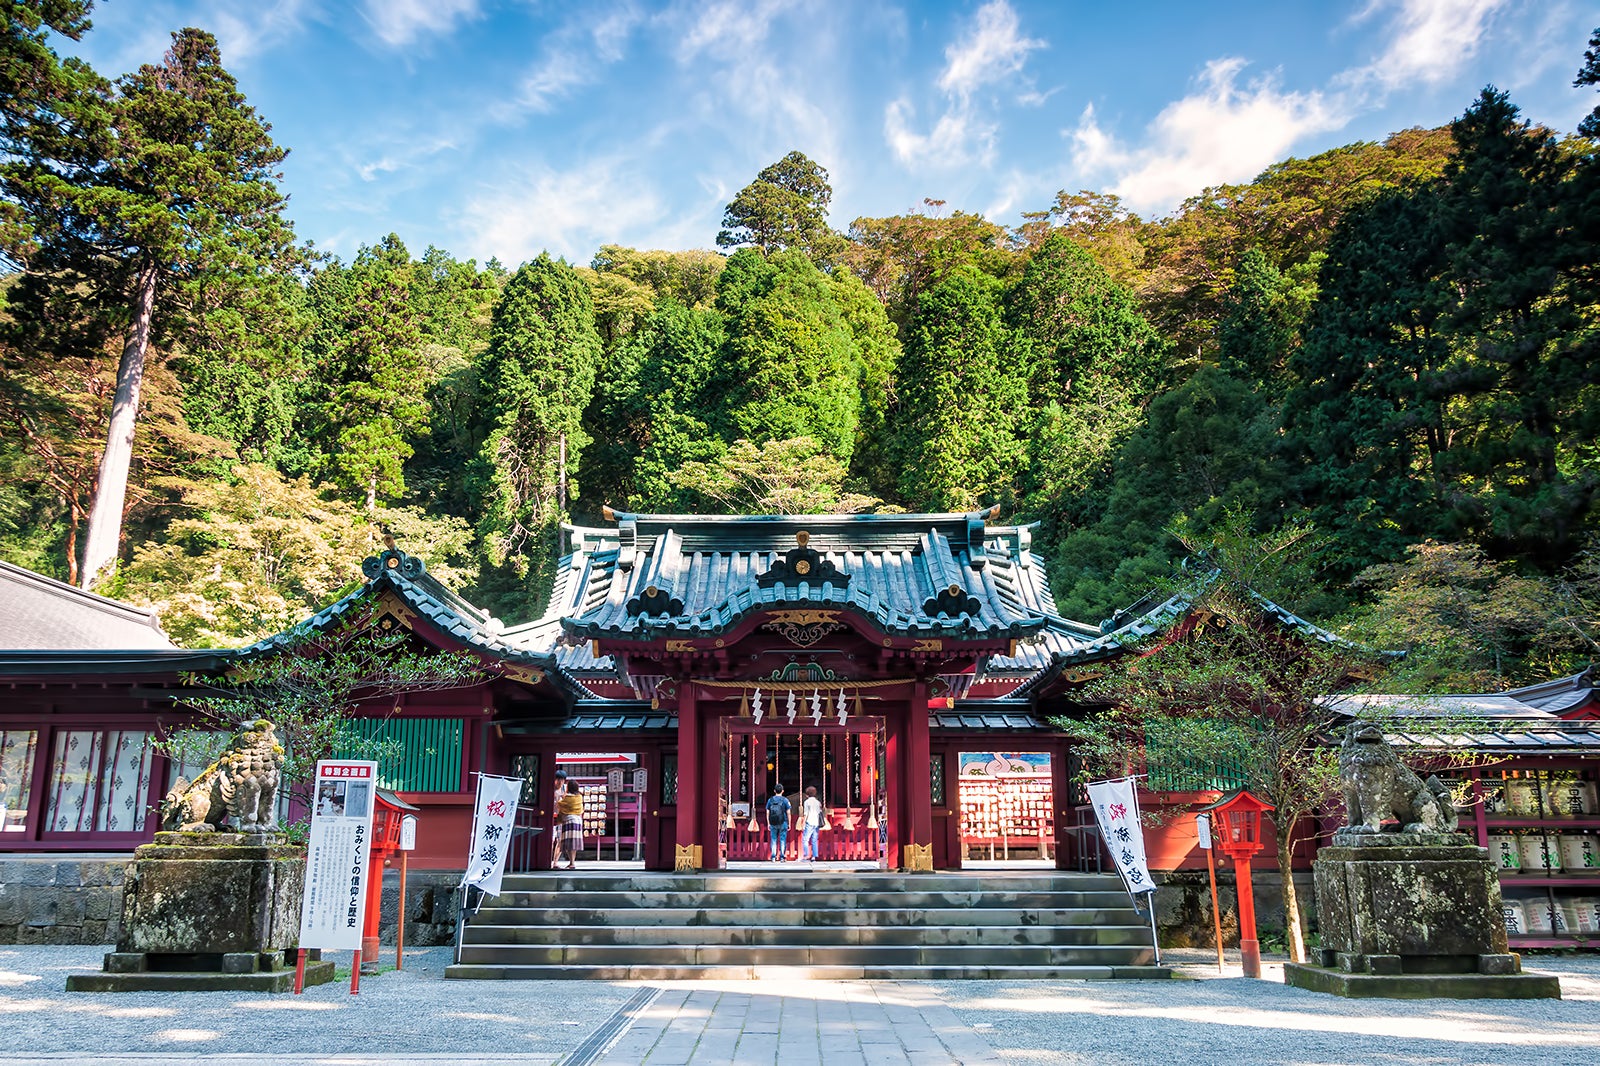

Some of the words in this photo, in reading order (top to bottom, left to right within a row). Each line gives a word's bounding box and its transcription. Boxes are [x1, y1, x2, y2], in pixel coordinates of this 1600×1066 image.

[347, 825, 365, 928] おみくじの信仰と歴史
